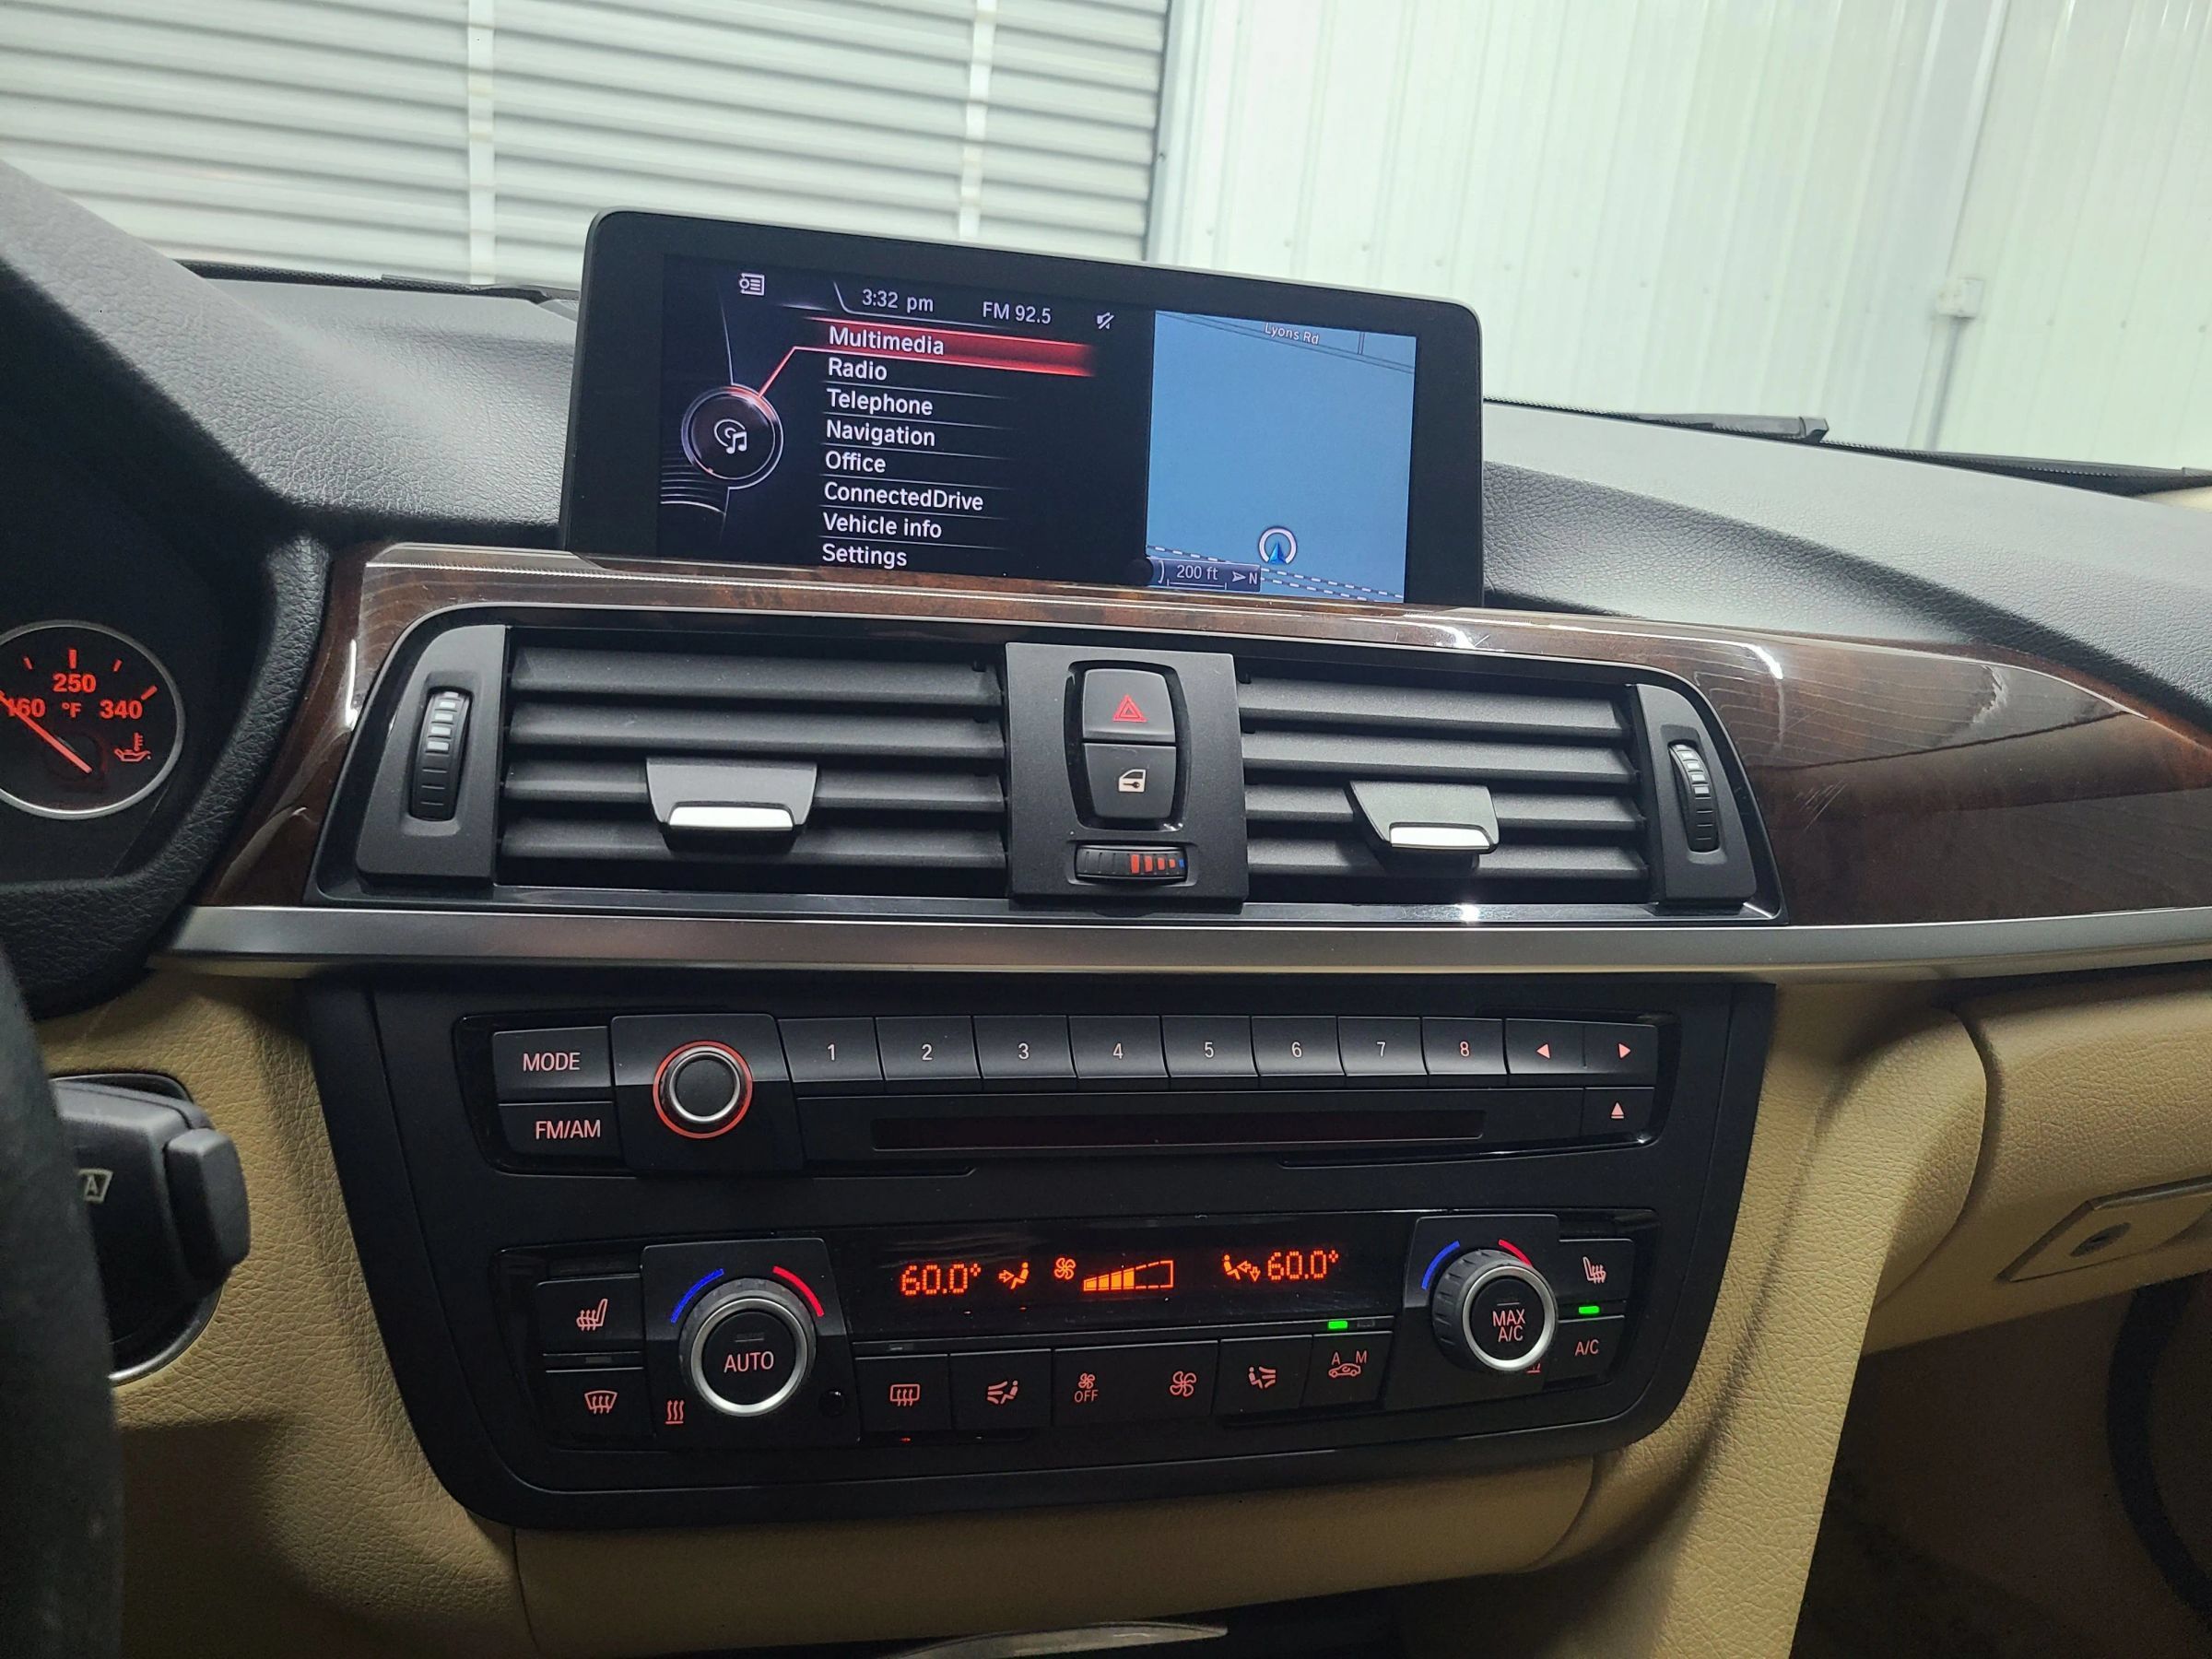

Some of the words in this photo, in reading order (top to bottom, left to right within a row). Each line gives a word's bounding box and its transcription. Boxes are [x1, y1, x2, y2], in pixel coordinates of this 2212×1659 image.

[862, 288, 899, 309] 3:32
[907, 294, 934, 315] pm
[982, 301, 1010, 321] FM
[1015, 304, 1053, 324] 92.5
[830, 325, 944, 356] Multimedia
[1265, 323, 1300, 342] Lyons
[1303, 330, 1319, 346] Rd
[829, 358, 888, 382] Radio
[827, 388, 934, 417] Telephone
[827, 419, 935, 447] Navigation
[825, 451, 887, 473] Office
[824, 482, 984, 512] ConnectedDrive
[823, 512, 898, 535] Vehicle
[903, 517, 942, 539] info
[822, 543, 908, 570] Settings
[1176, 565, 1204, 581] 200
[1206, 568, 1218, 582] ft
[1249, 572, 1258, 585] N
[52, 673, 97, 693] 250
[99, 699, 143, 719] 340
[828, 1043, 835, 1061] 1
[922, 1043, 933, 1061] 2
[1018, 1042, 1030, 1060] 3
[1112, 1042, 1124, 1060] 4
[1204, 1041, 1215, 1059] 5
[1291, 1041, 1303, 1059] 6
[1376, 1041, 1386, 1058] 7
[1459, 1041, 1470, 1058] 8
[523, 1052, 581, 1072] MODE
[535, 1119, 601, 1139] FM/AM
[1492, 1309, 1526, 1328] MAX
[1497, 1325, 1524, 1343] A/C
[1331, 1351, 1342, 1365] A
[1355, 1350, 1368, 1364] M
[1574, 1339, 1599, 1356] A/C
[724, 1350, 774, 1373] AUTO
[1074, 1389, 1099, 1404] OFF
